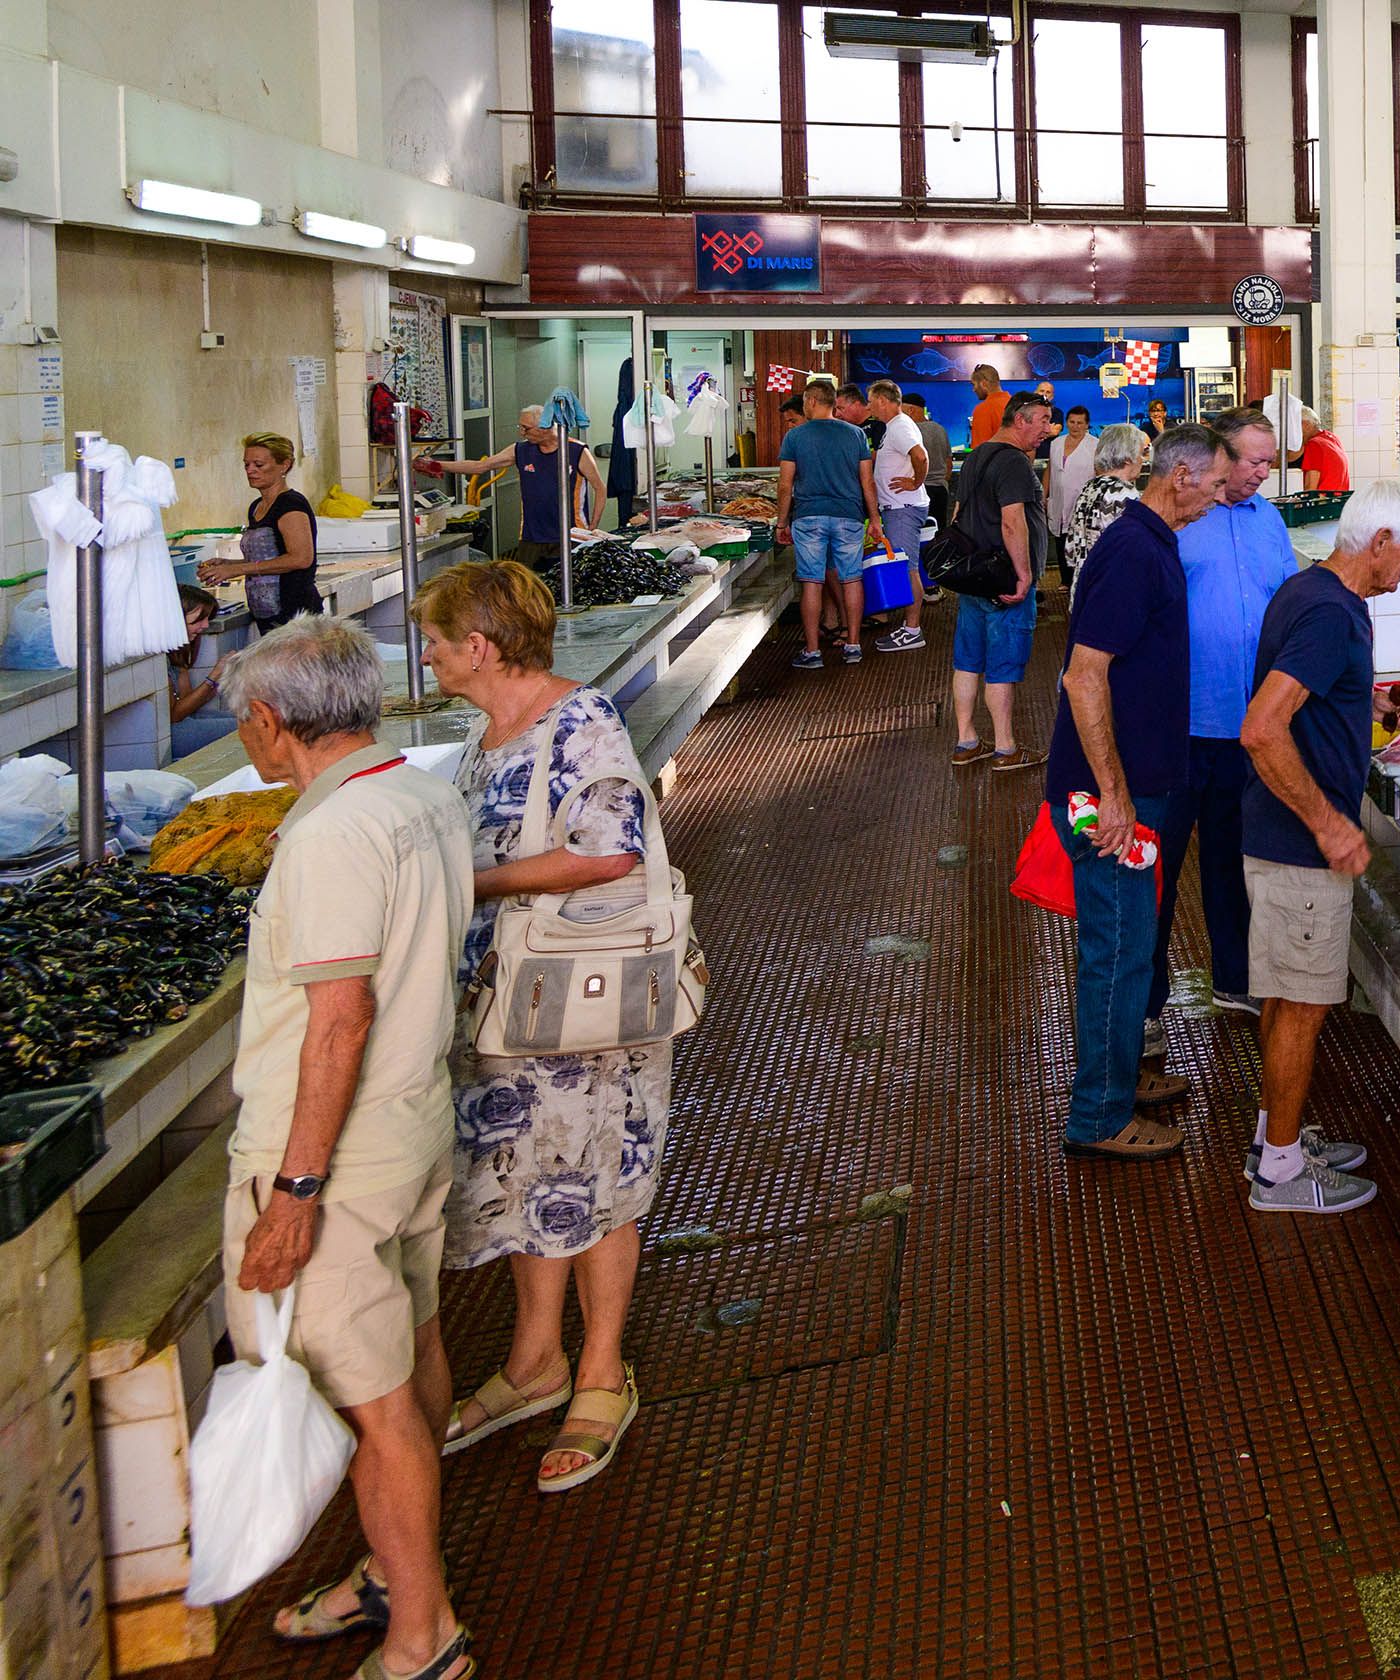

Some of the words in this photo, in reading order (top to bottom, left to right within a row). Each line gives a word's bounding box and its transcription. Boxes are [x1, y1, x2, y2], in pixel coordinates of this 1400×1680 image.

[747, 257, 763, 269] DI
[766, 256, 814, 270] MARIS
[1235, 281, 1250, 304] SAMO
[1251, 277, 1282, 304] NAJBOLJE
[1242, 311, 1252, 321] IZ
[1252, 312, 1276, 323] MORA
